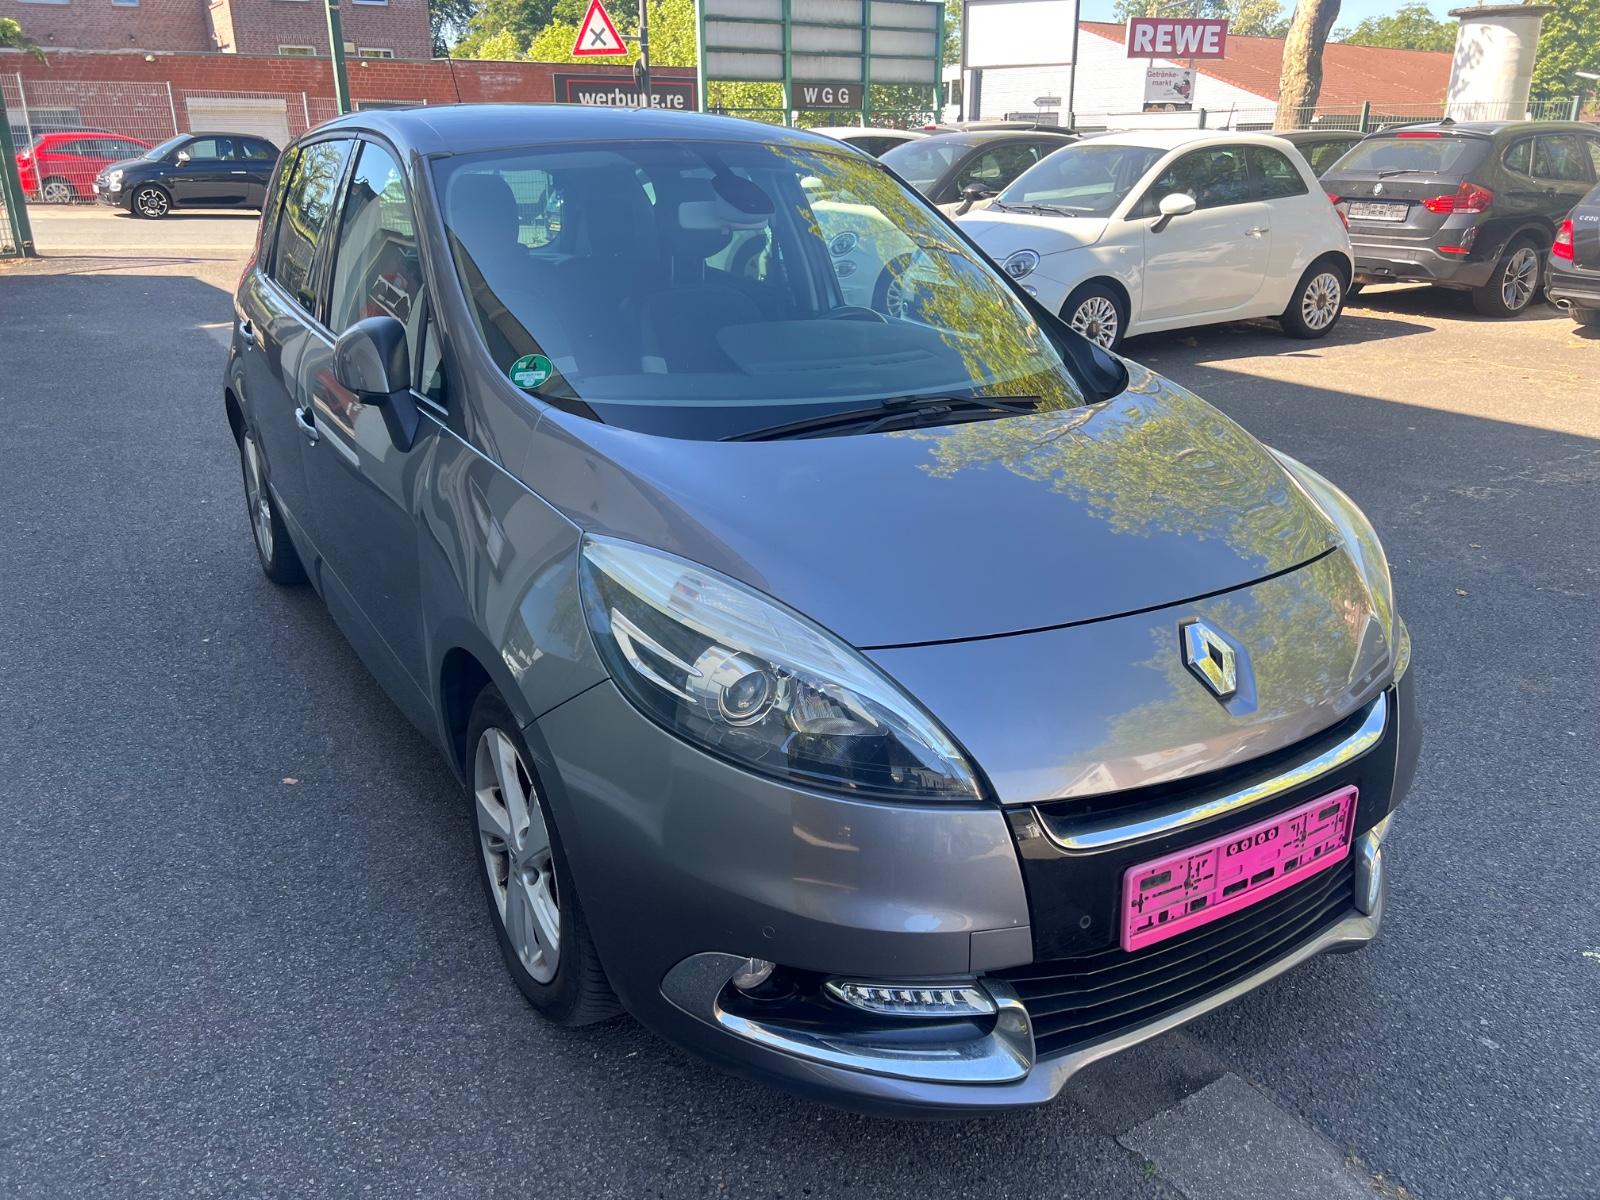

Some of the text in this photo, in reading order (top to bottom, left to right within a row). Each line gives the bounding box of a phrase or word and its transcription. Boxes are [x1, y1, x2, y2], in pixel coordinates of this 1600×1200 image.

[1133, 25, 1221, 54] REWE
[1147, 70, 1179, 78] Getränke-
[525, 356, 538, 371] 4
